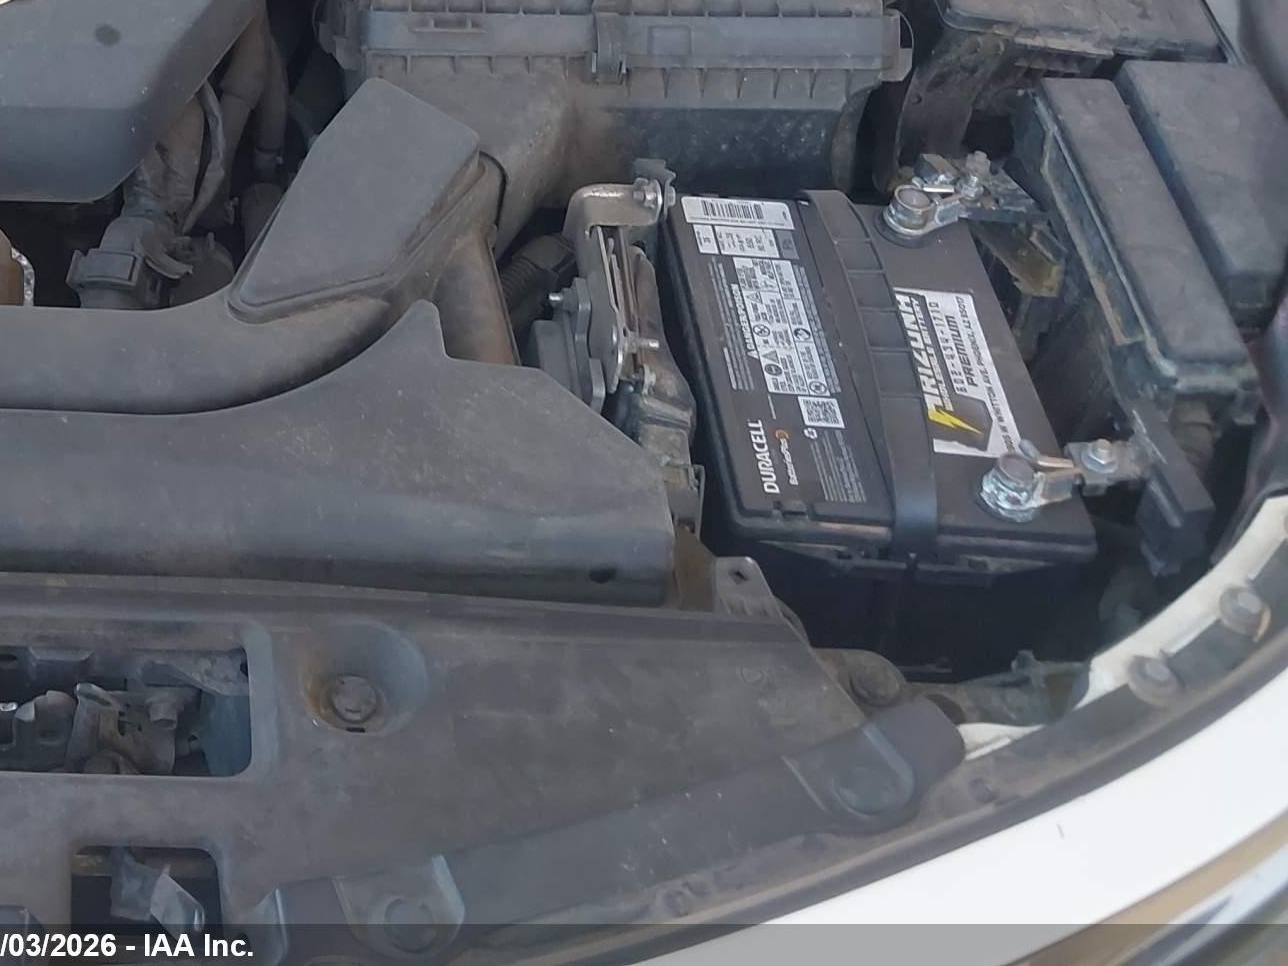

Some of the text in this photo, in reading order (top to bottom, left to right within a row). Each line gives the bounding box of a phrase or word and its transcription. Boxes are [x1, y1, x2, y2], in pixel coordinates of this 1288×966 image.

[910, 297, 955, 412] WHOLESALE BATTERY
[944, 315, 978, 387] PREMIUM
[986, 386, 1004, 423] WHITTON
[747, 419, 780, 494] DURACELL
